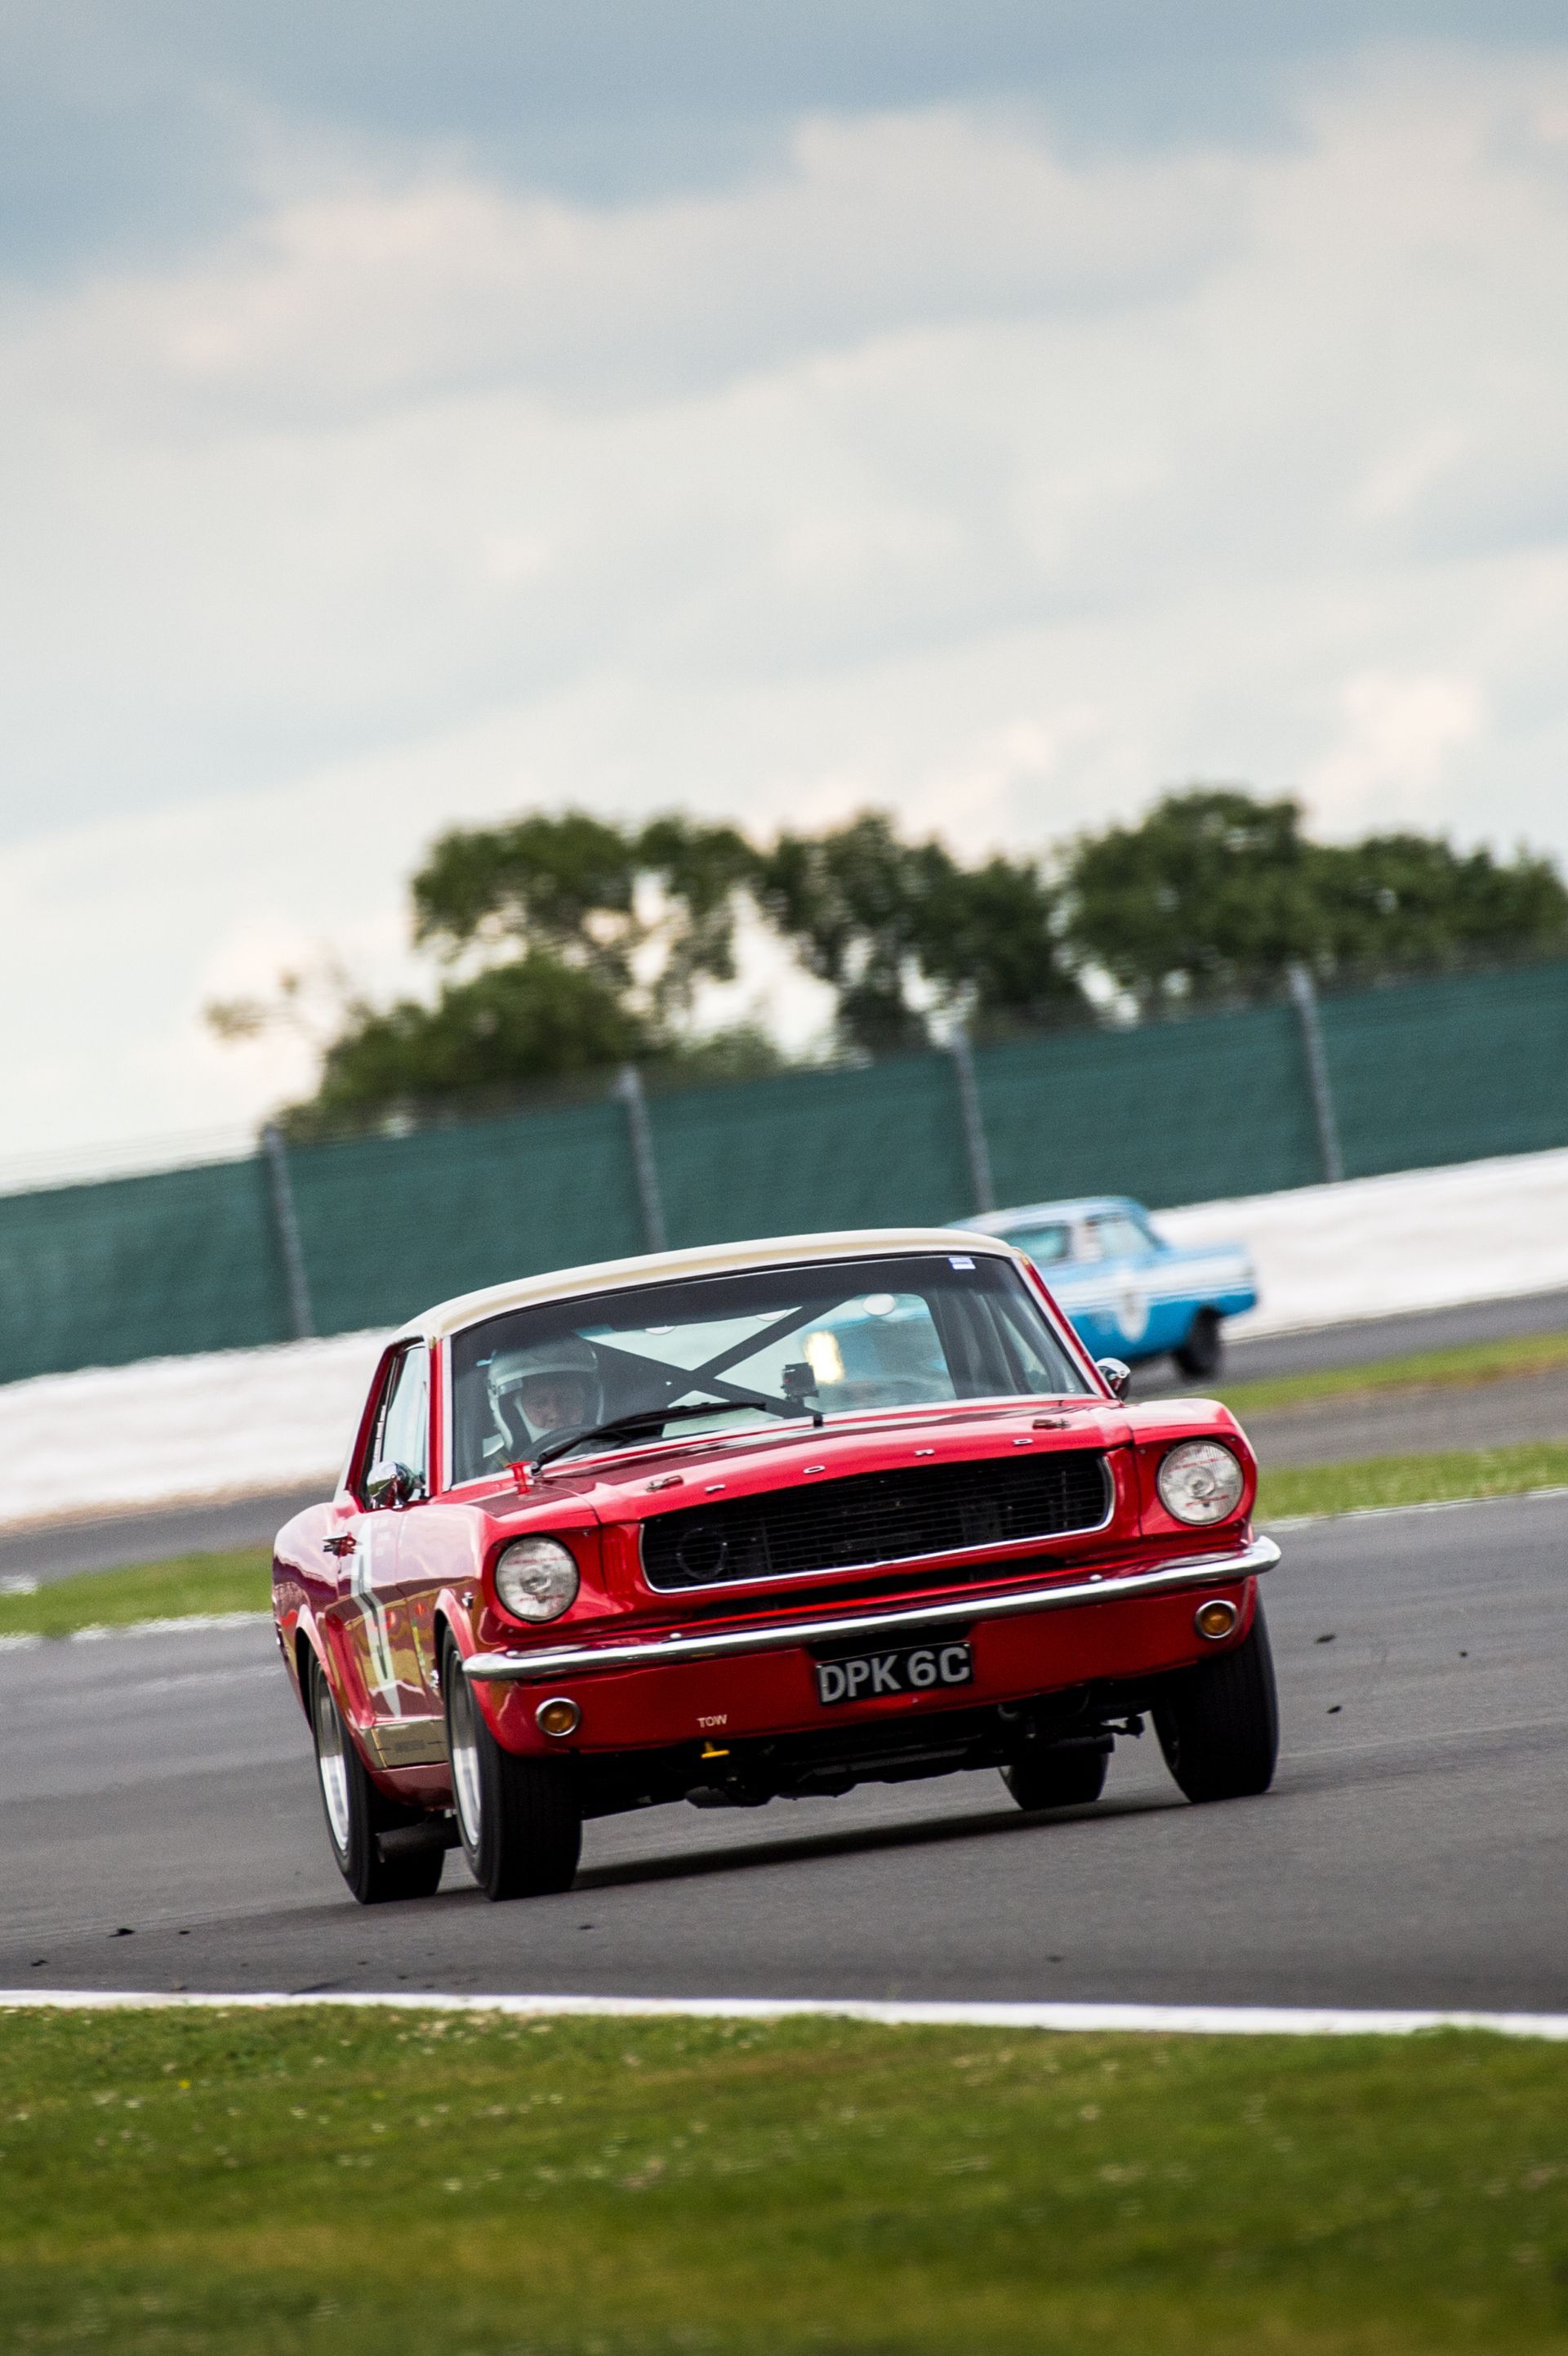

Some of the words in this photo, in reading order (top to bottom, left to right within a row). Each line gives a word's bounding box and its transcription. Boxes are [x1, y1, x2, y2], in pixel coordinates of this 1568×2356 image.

[820, 1655, 902, 1702] DPK
[907, 1647, 970, 1687] 6C
[697, 1714, 728, 1728] TOW
